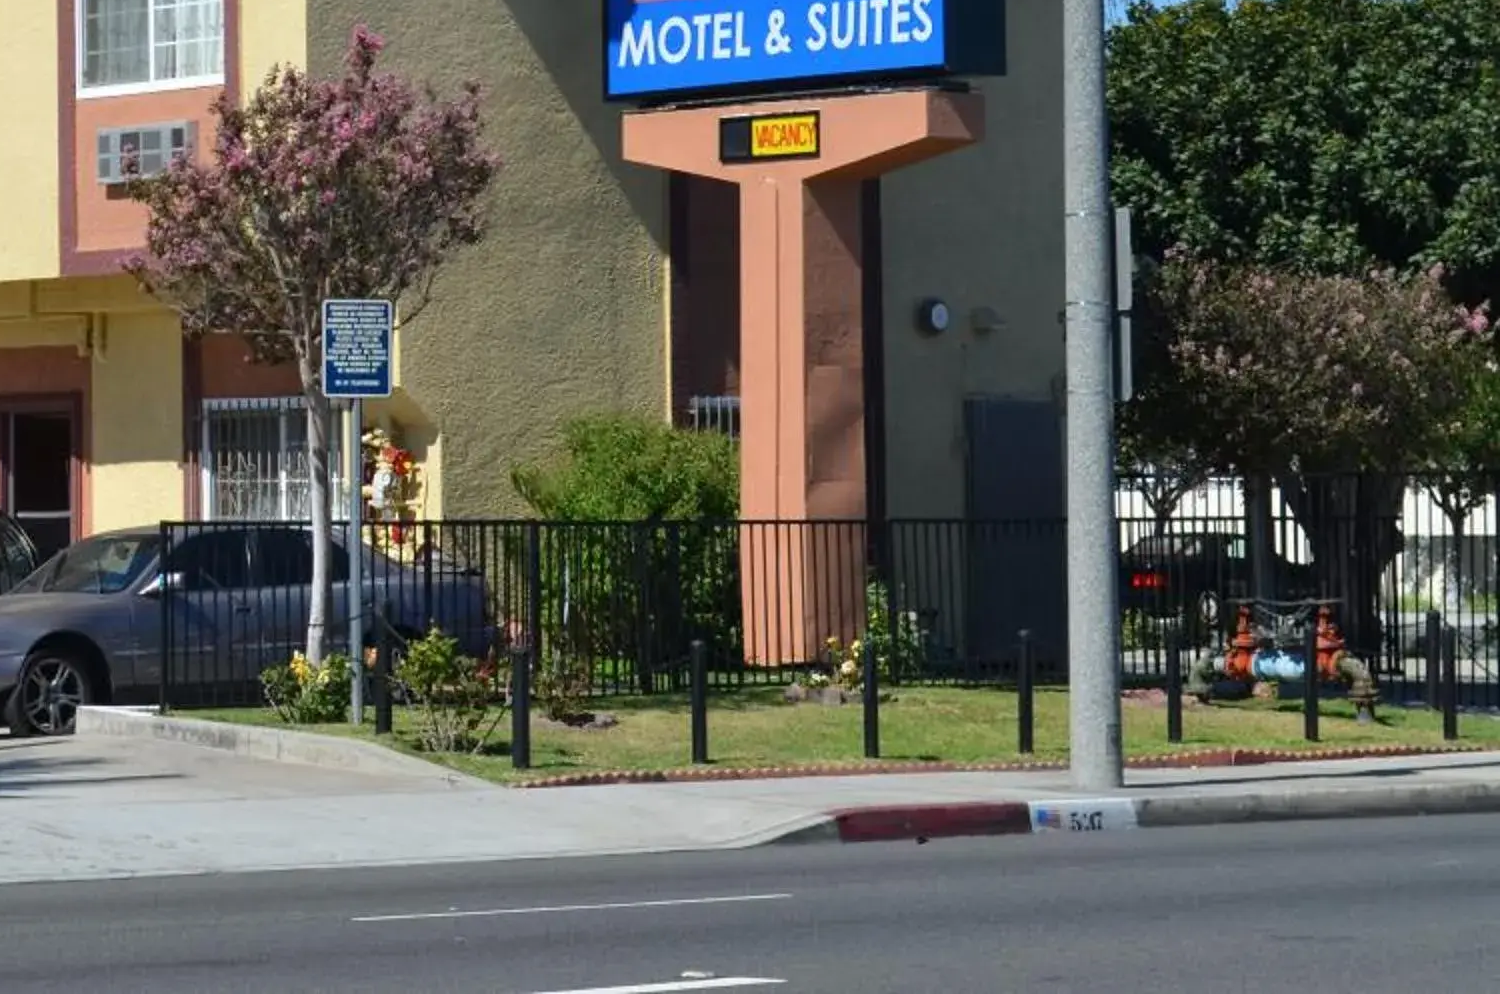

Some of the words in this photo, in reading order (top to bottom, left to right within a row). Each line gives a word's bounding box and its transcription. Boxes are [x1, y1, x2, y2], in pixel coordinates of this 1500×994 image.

[618, 11, 751, 68] MOTEL
[764, 8, 791, 55] &
[755, 121, 815, 148] VACANCY
